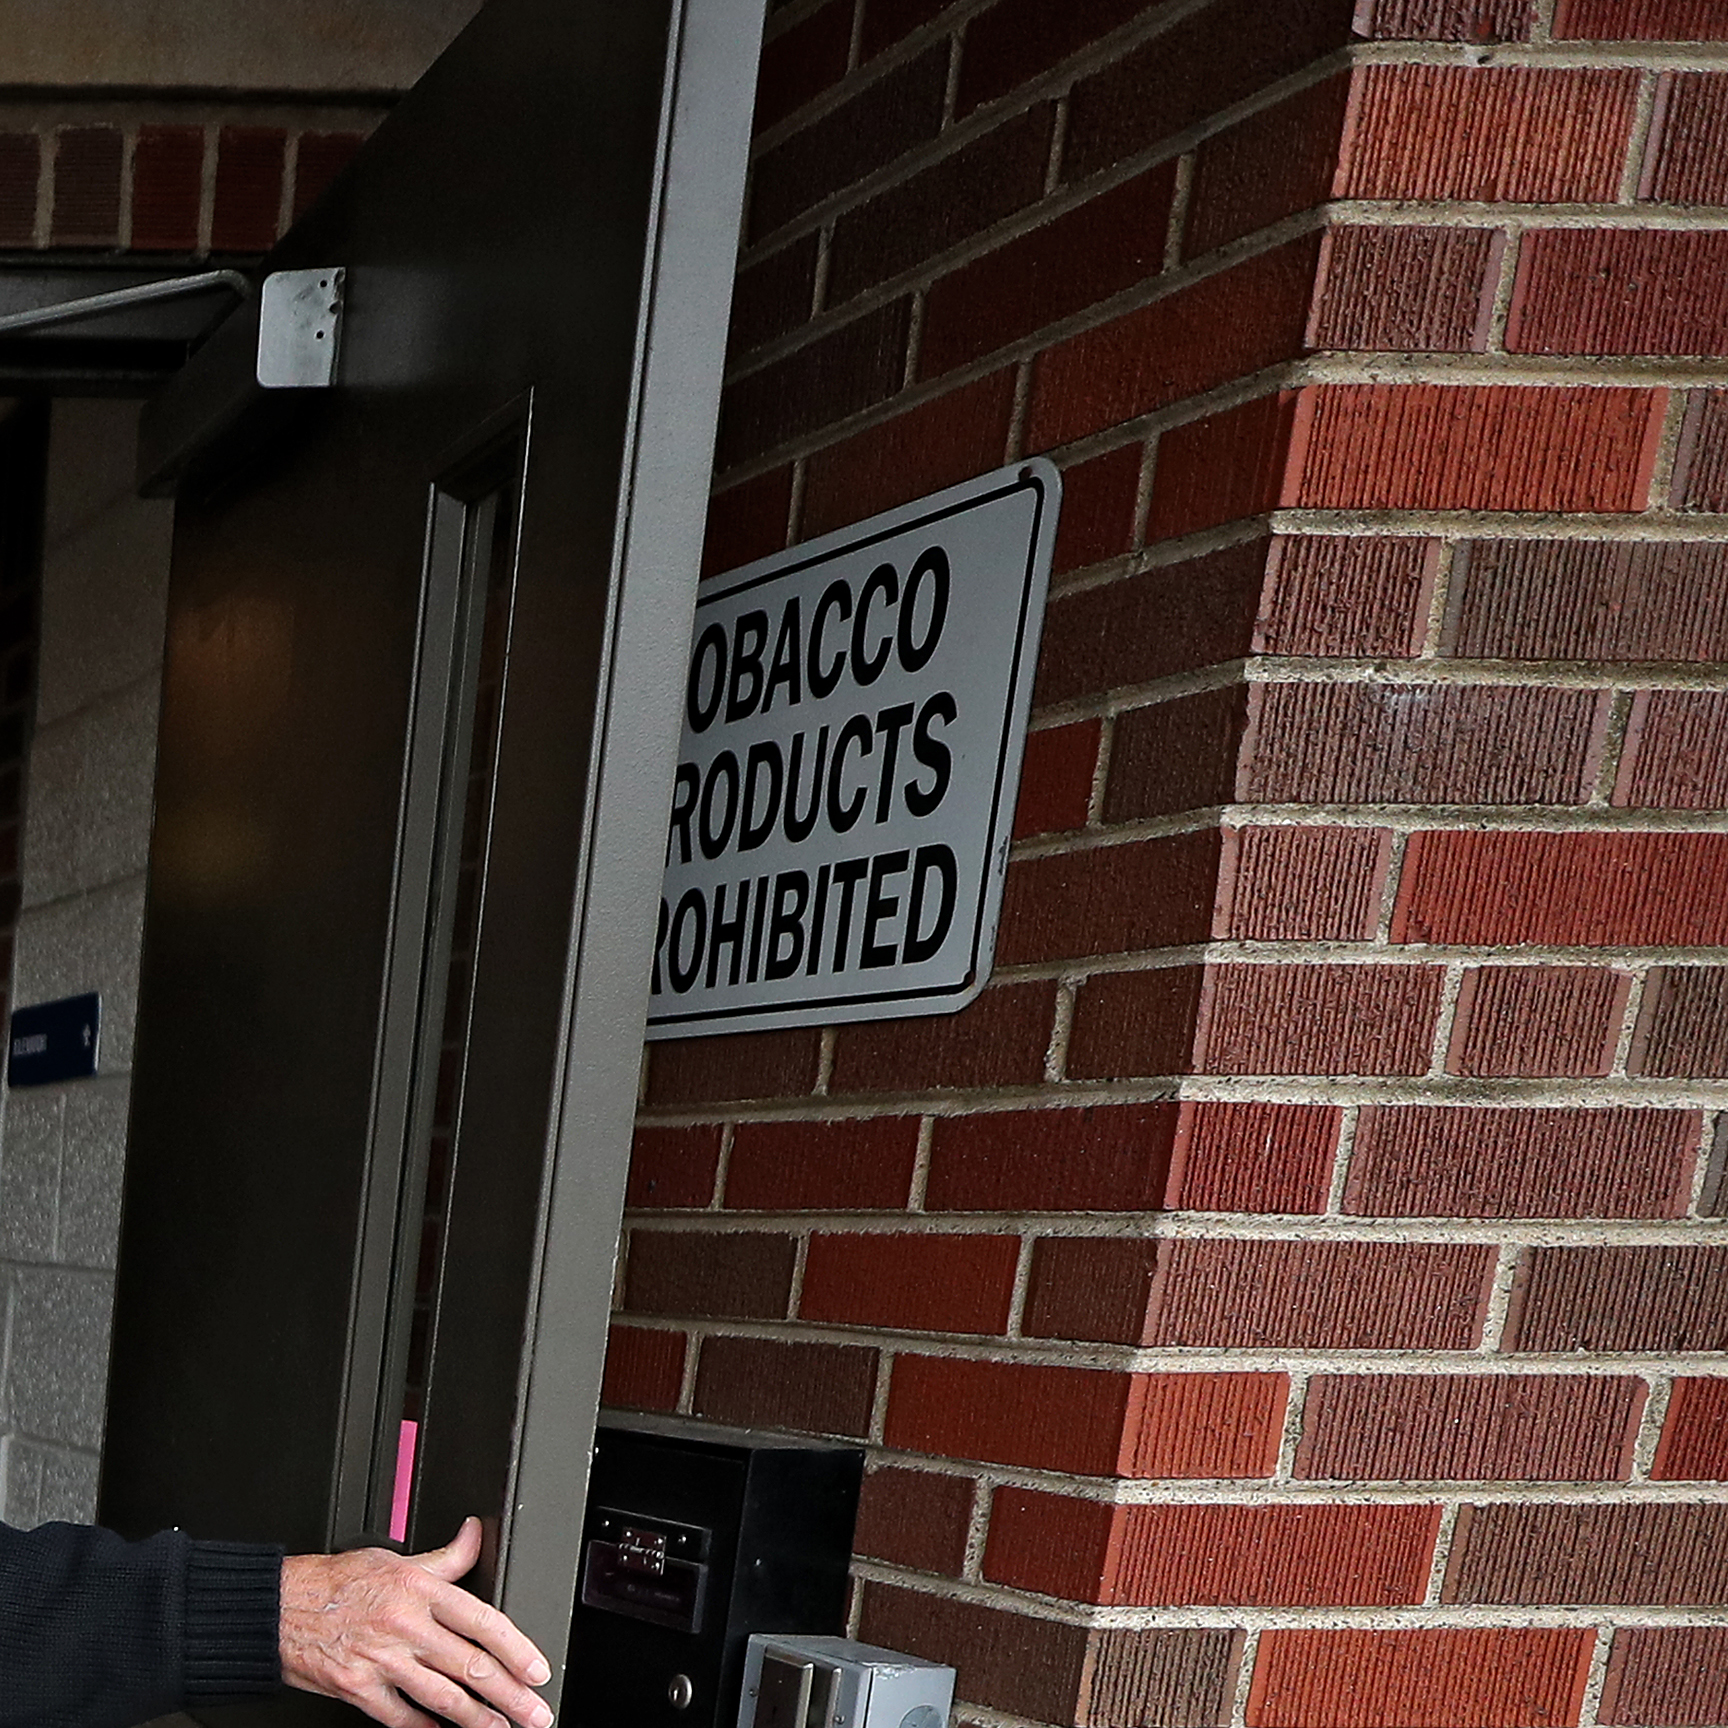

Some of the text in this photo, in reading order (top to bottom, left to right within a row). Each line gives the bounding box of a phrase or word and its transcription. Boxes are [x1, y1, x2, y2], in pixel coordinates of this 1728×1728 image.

[687, 545, 950, 734] OBACCO
[665, 691, 957, 868] RODUCTS
[650, 843, 957, 995] OHIBITED
